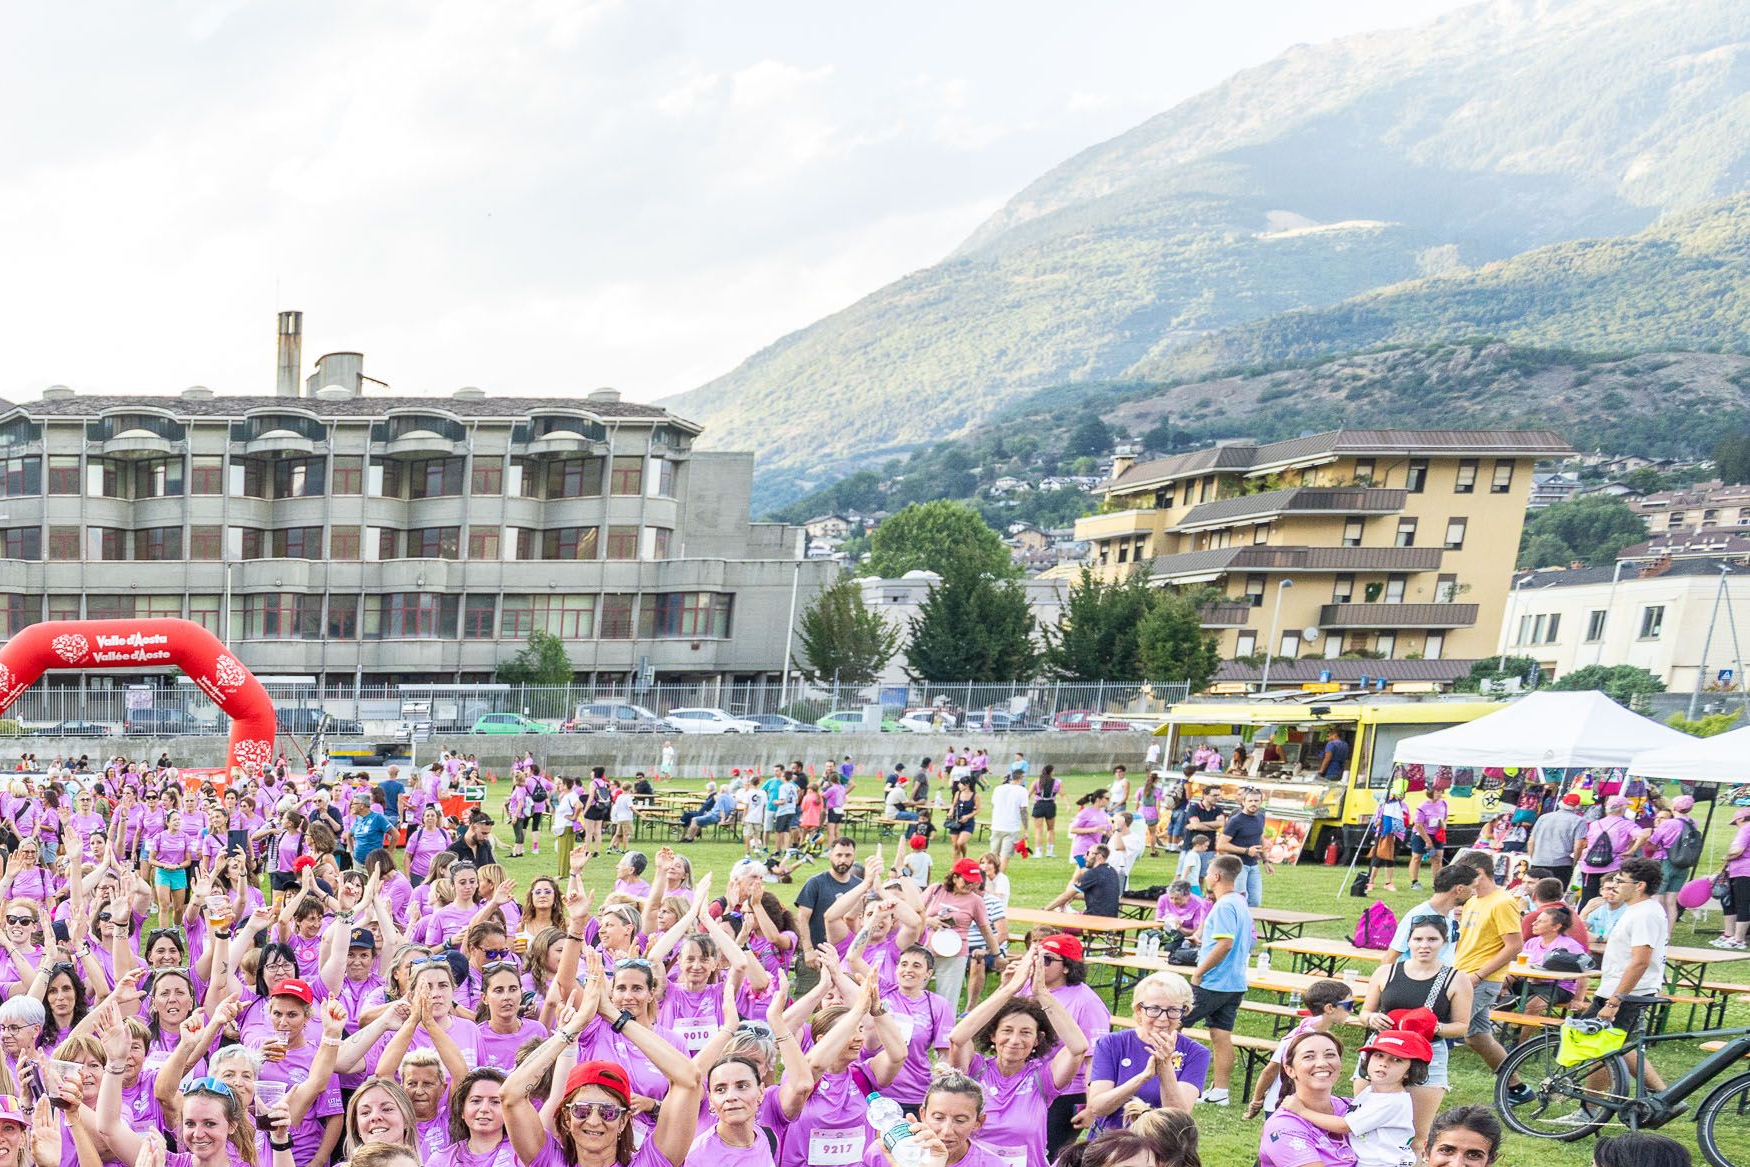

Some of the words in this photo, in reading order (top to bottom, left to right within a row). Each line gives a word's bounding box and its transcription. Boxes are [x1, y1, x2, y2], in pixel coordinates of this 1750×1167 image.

[96, 634, 126, 649] Valle
[127, 631, 168, 647] d'Aosta
[92, 650, 130, 663] Vallée
[131, 648, 171, 662] d'Aoste
[683, 1031, 709, 1040] 9010
[823, 1143, 853, 1155] 9217
